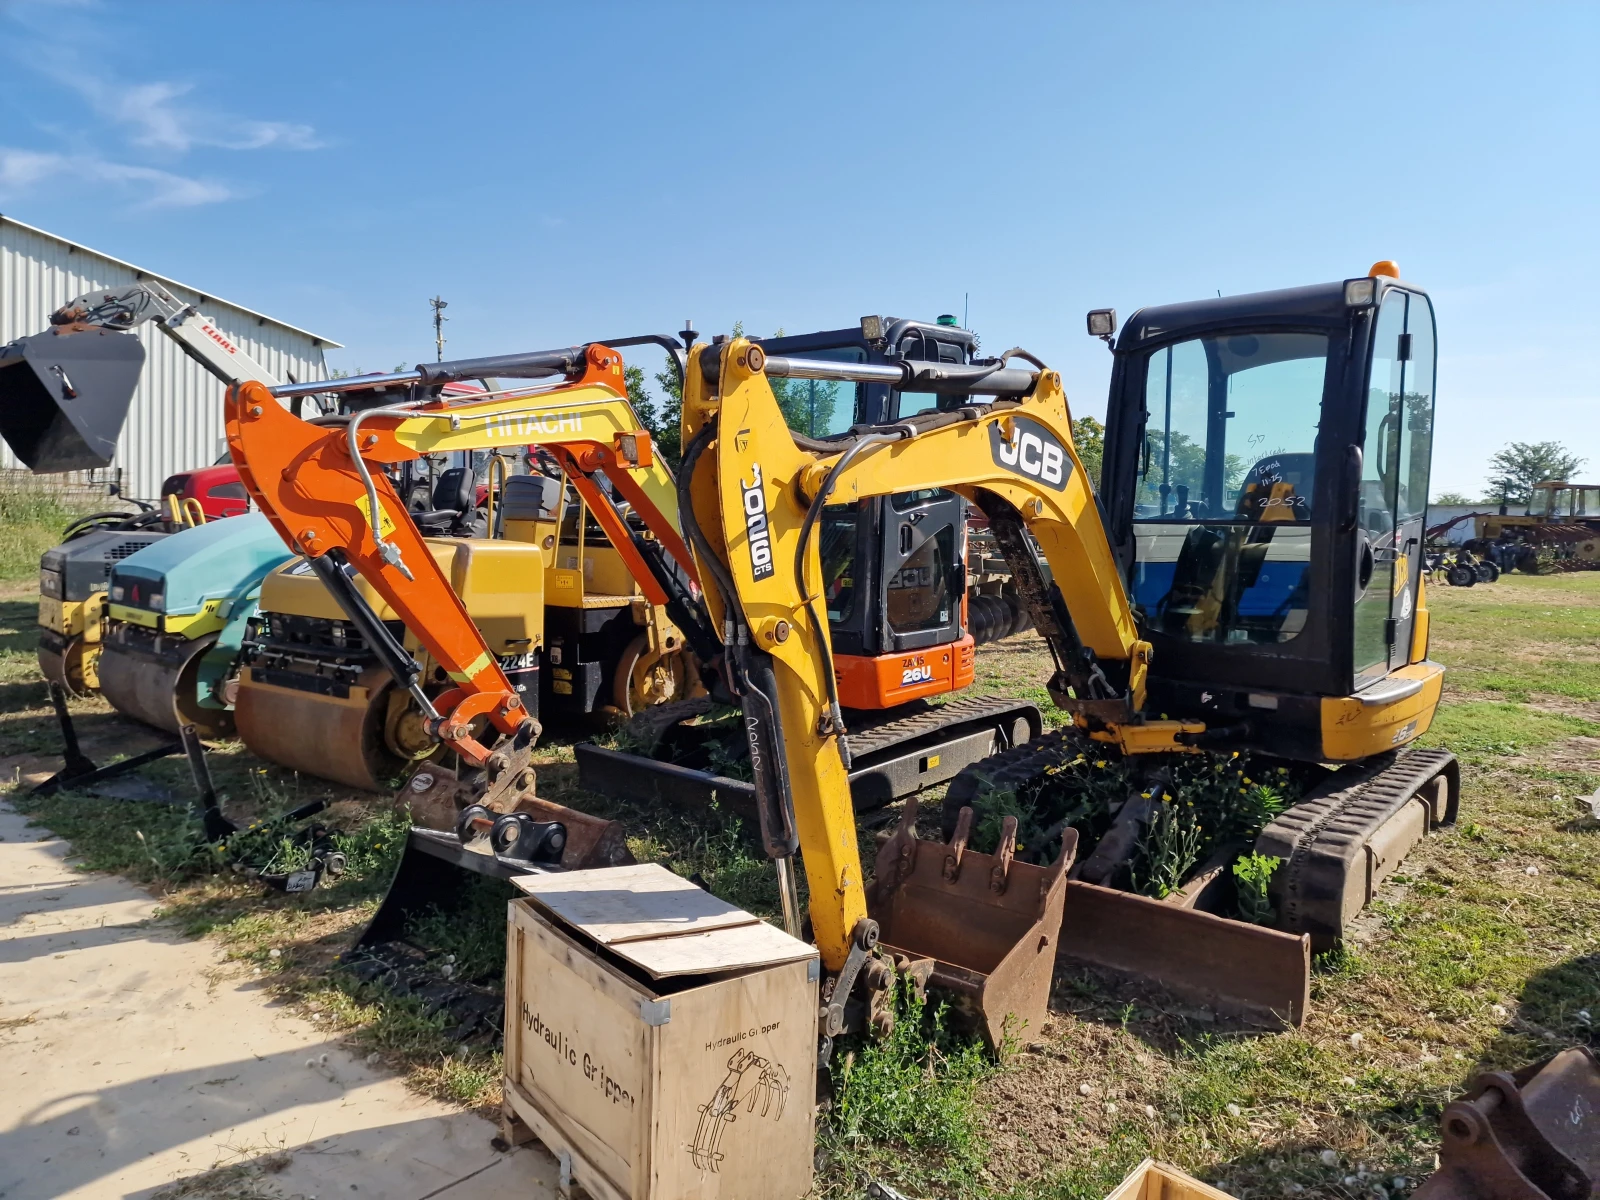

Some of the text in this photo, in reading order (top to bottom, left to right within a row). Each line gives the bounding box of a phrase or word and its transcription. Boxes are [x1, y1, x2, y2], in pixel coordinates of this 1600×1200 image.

[202, 325, 237, 354] CLAAS
[485, 412, 582, 438] HITACHI
[999, 427, 1063, 484] JCB
[1258, 496, 1306, 508] 2052
[754, 563, 772, 576] CTS
[902, 665, 931, 684] 26U
[746, 716, 761, 771] 2052
[522, 1001, 577, 1066] Hydraulic
[705, 1031, 747, 1052] Hydraulic
